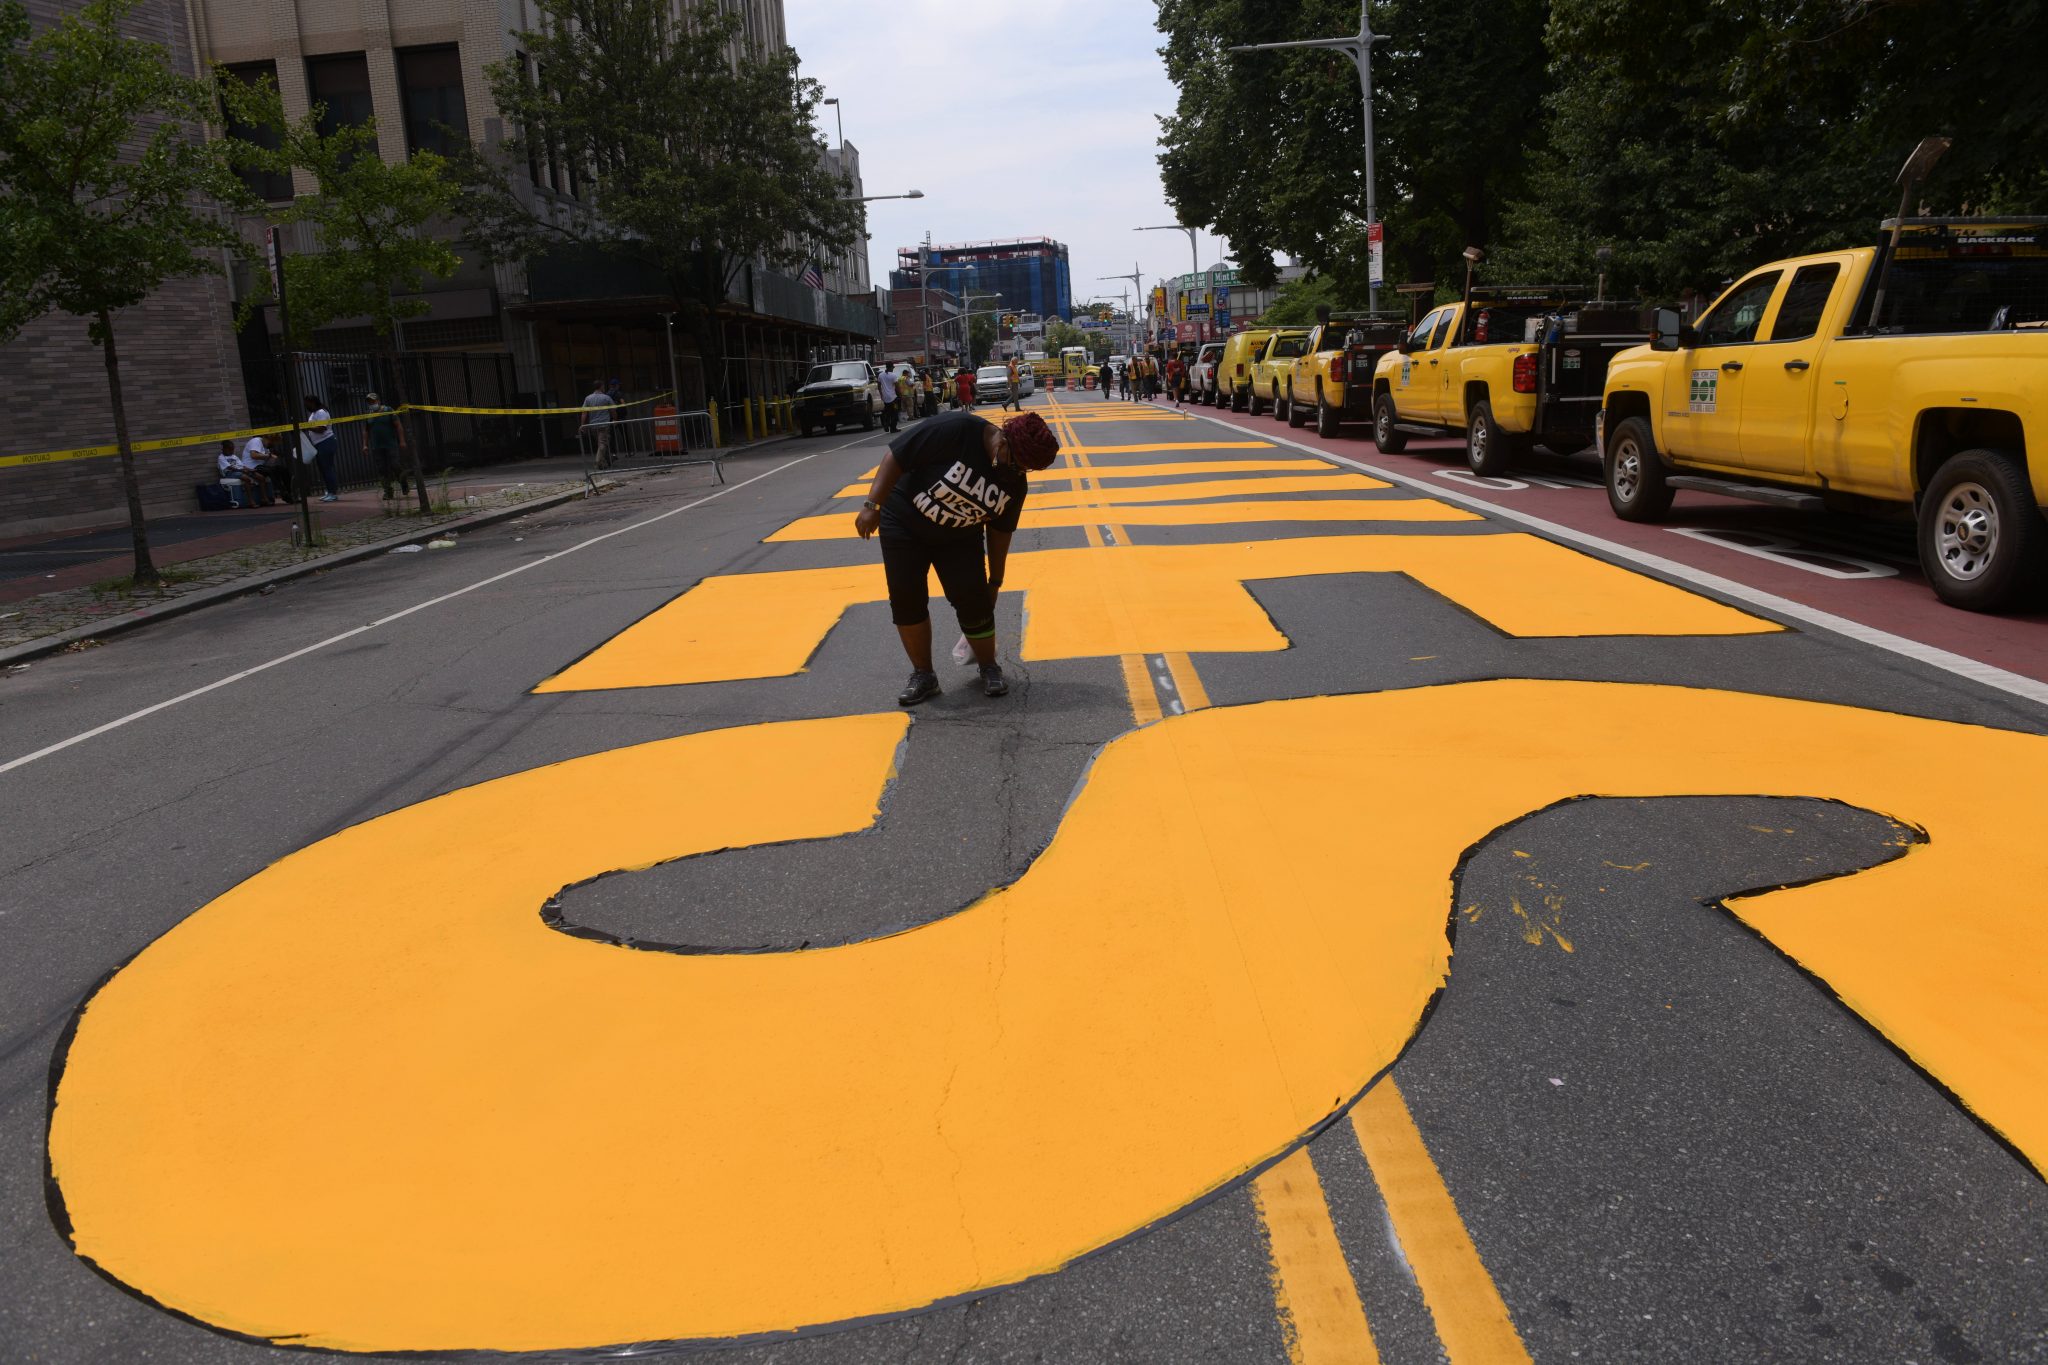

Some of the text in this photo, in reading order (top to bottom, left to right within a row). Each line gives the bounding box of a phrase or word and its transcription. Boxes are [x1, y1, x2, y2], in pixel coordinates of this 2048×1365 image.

[1690, 379, 1716, 402] DOT
[928, 481, 986, 520] LIVES
[944, 460, 1011, 516] BLACK
